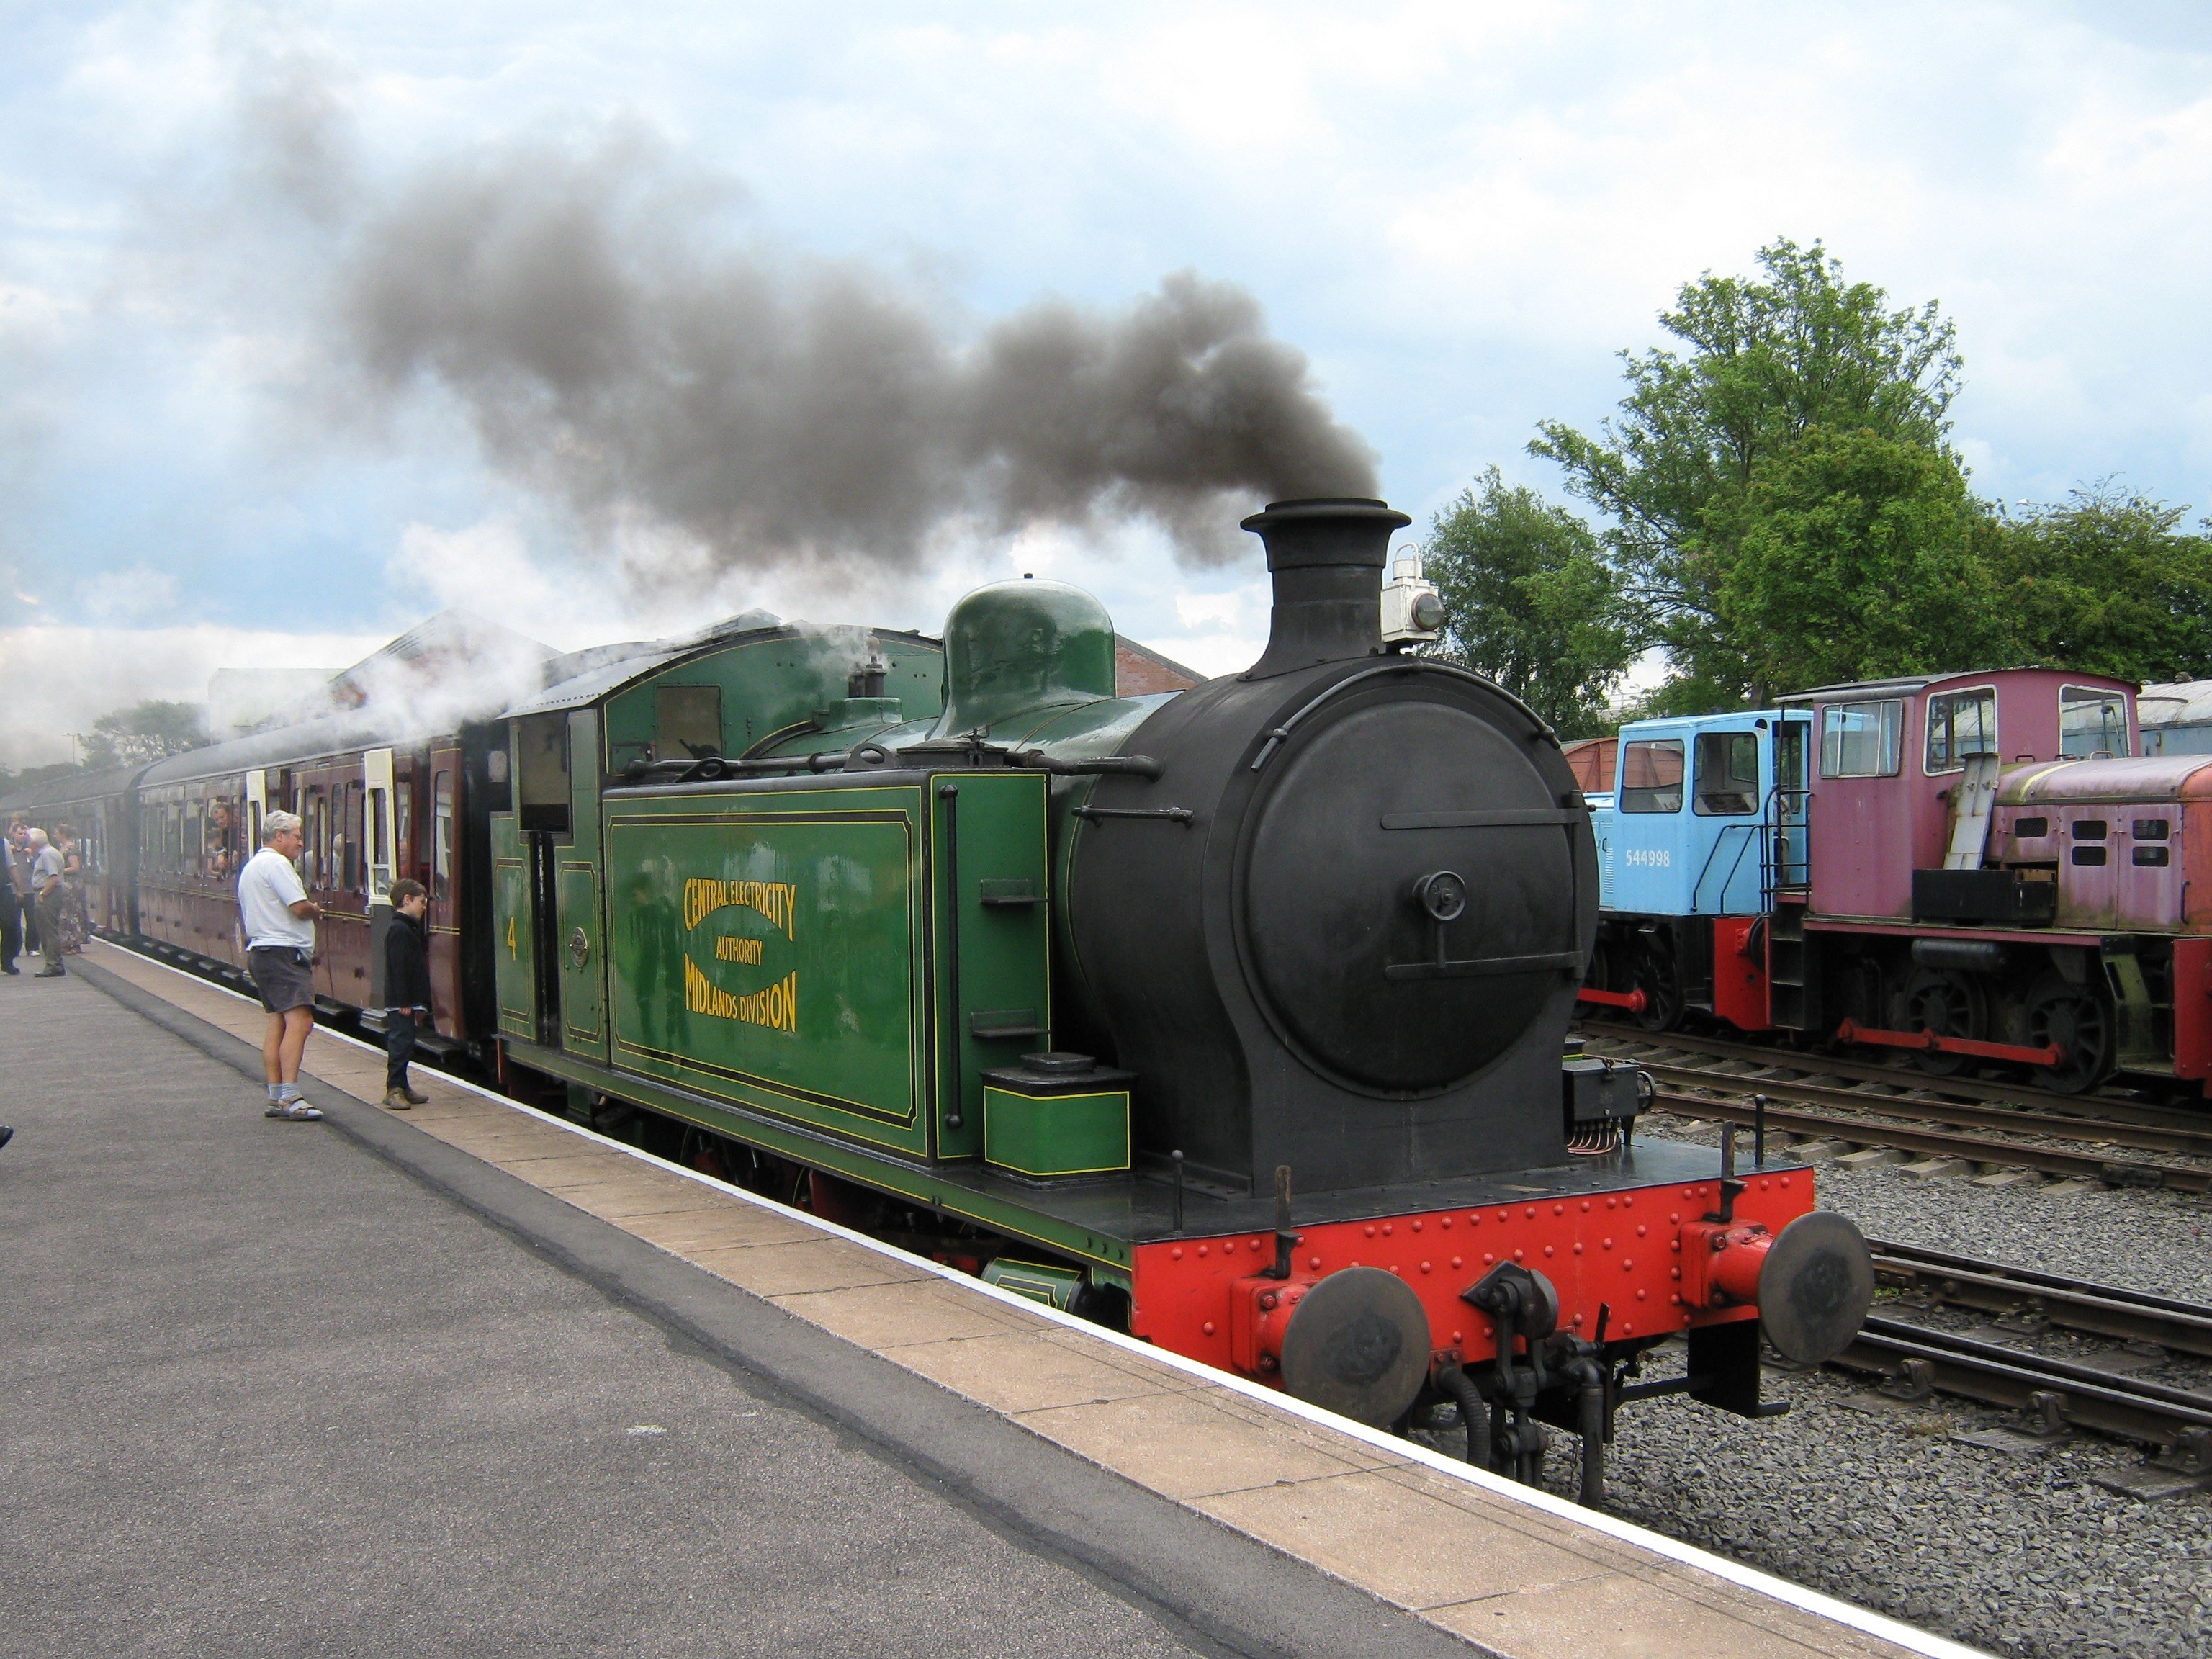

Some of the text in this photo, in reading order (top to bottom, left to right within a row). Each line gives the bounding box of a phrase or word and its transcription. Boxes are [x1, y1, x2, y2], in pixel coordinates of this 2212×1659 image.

[1626, 849, 1670, 867] 544998
[684, 878, 796, 943] CENTRAL ELECTRICITY
[508, 917, 516, 961] 4
[716, 936, 764, 966] AUTHORITY
[685, 951, 796, 1033] MIDLANDS DIVISION
